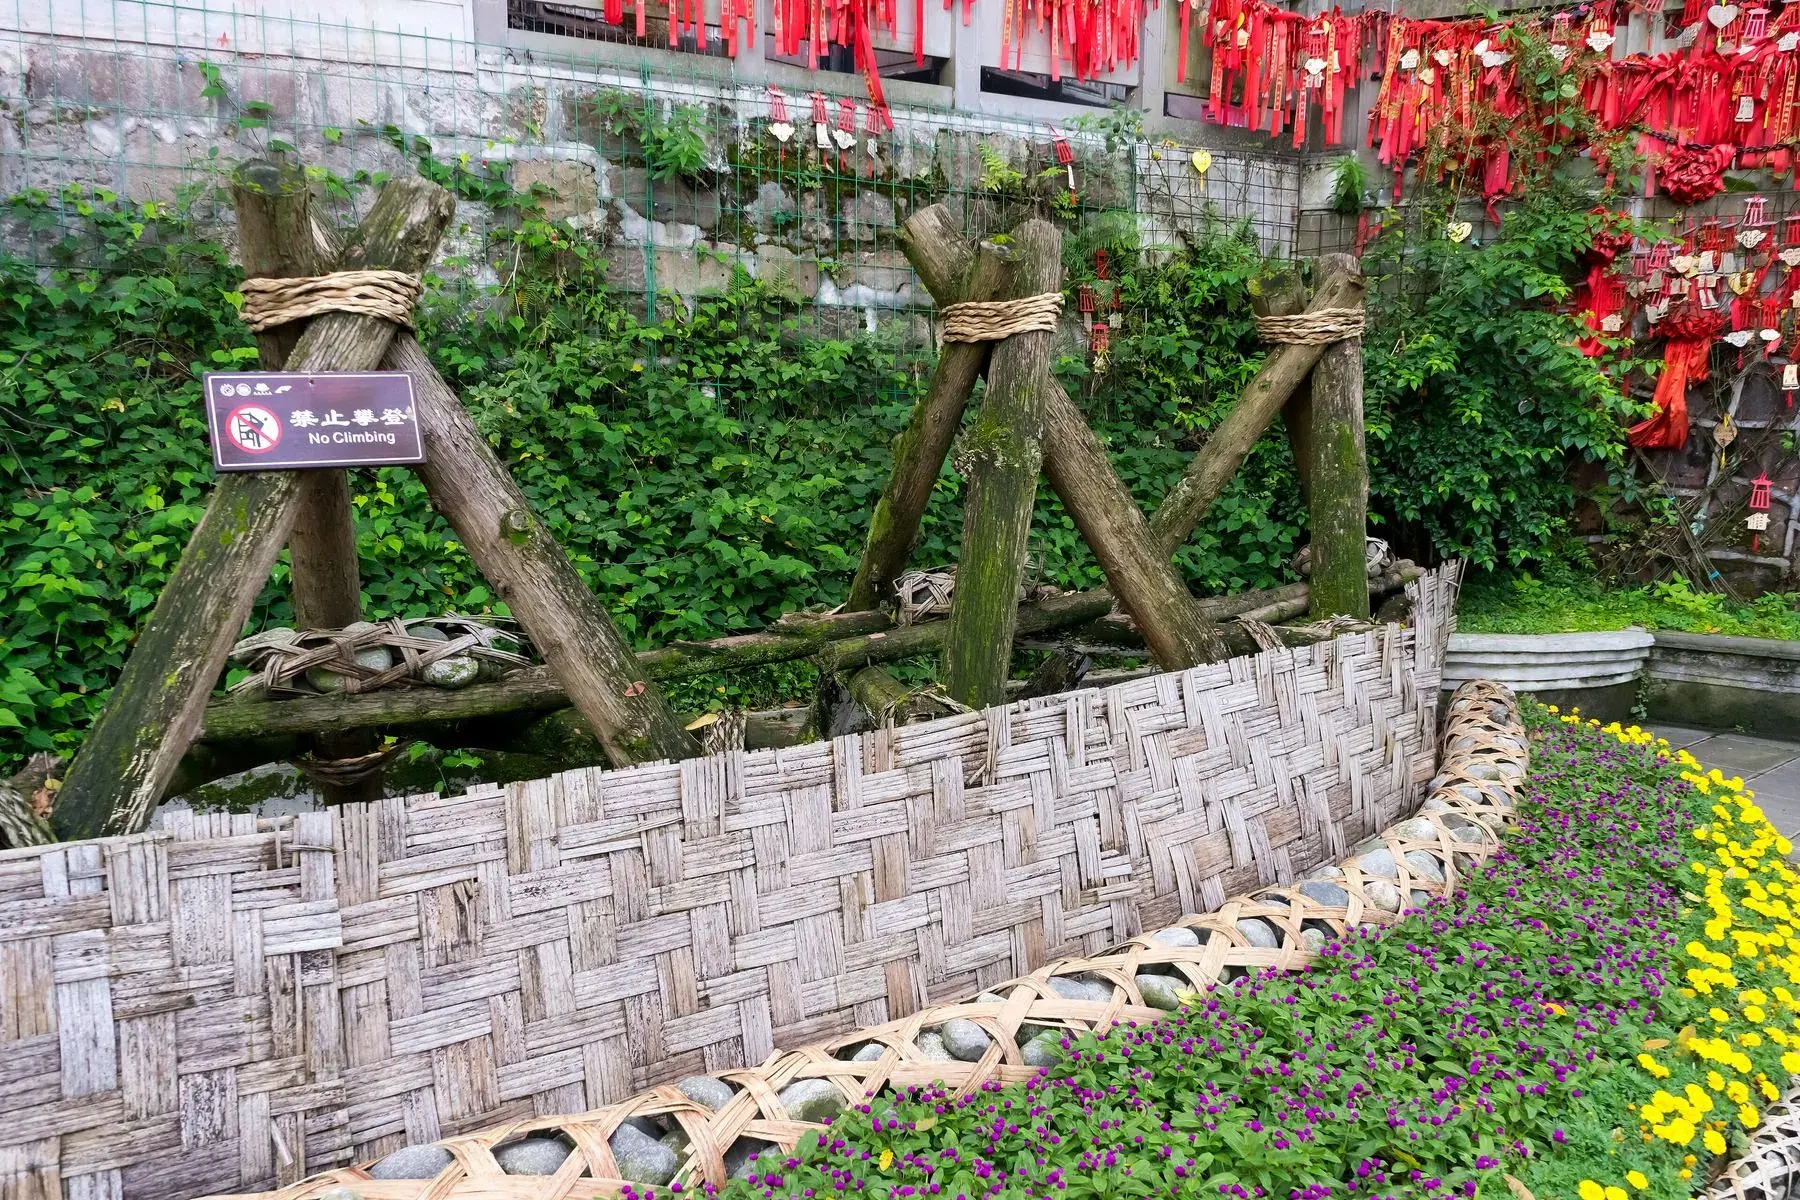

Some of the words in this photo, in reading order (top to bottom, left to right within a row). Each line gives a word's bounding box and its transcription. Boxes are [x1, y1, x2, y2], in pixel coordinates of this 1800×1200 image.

[290, 408, 408, 428] 禁止攀登
[308, 432, 330, 444] No
[332, 431, 396, 445] Climbing
